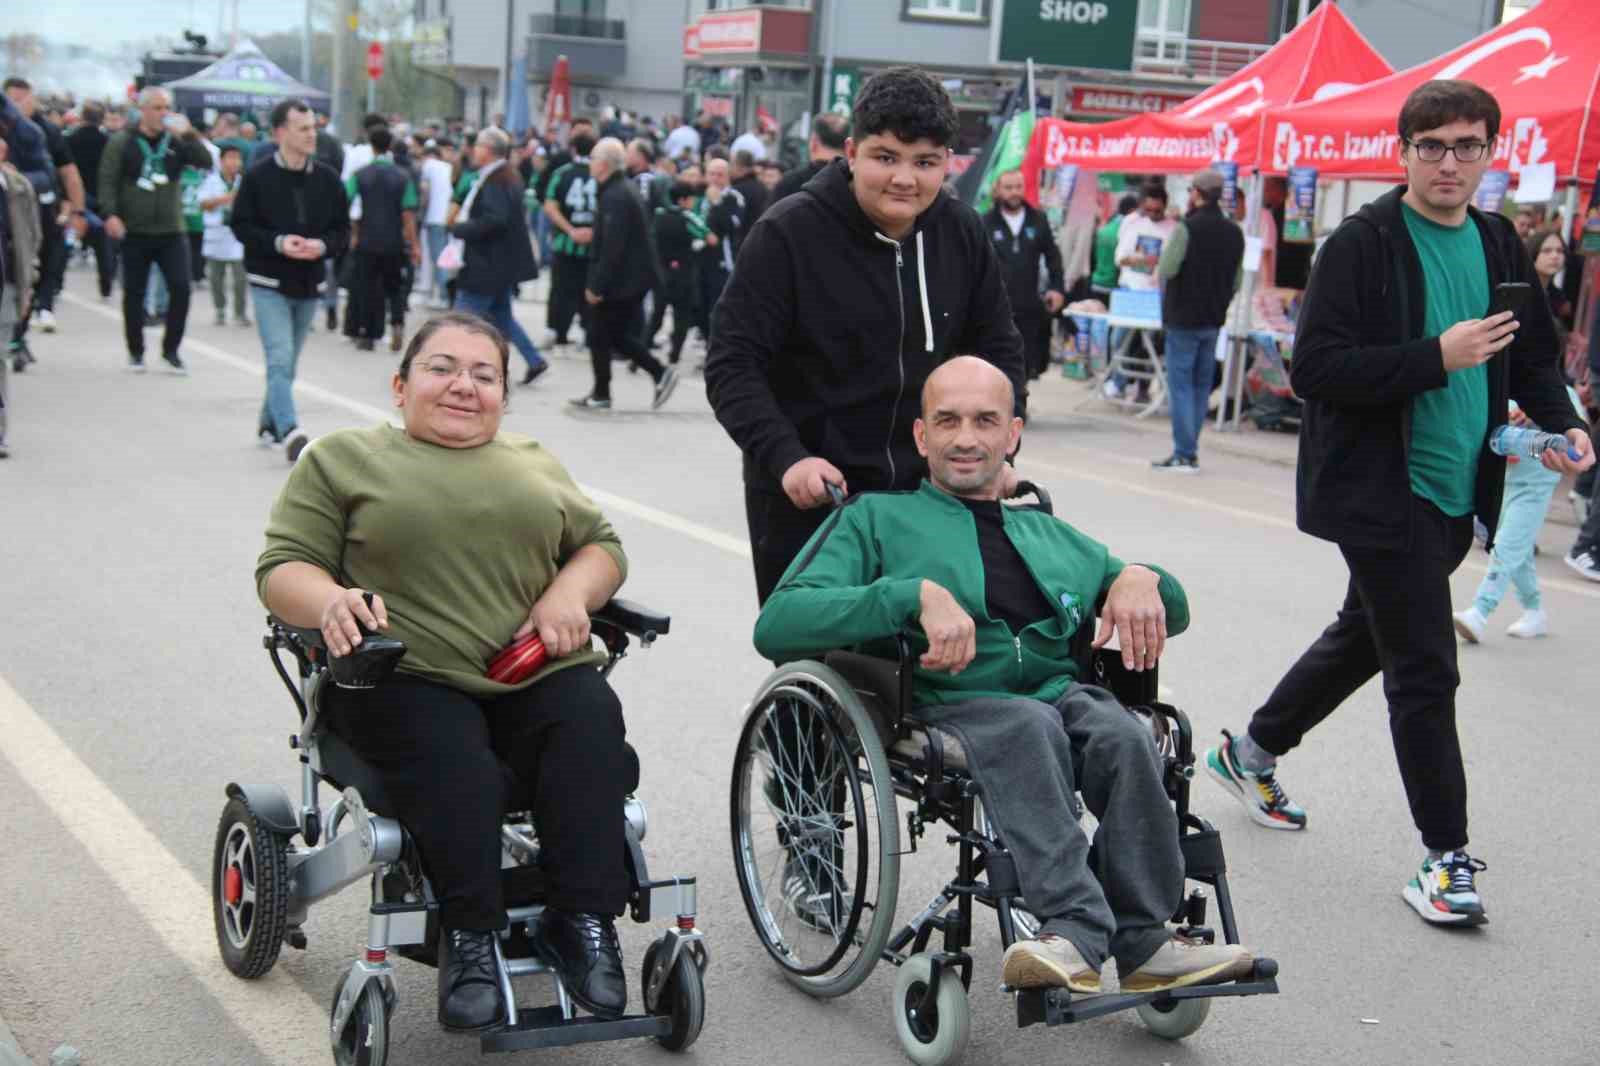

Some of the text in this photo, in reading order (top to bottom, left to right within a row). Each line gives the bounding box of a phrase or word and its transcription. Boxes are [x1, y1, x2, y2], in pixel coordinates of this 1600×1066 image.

[1040, 0, 1108, 25] SHOP
[1303, 129, 1400, 160] T.C. İZMİT
[565, 177, 597, 212] 41
